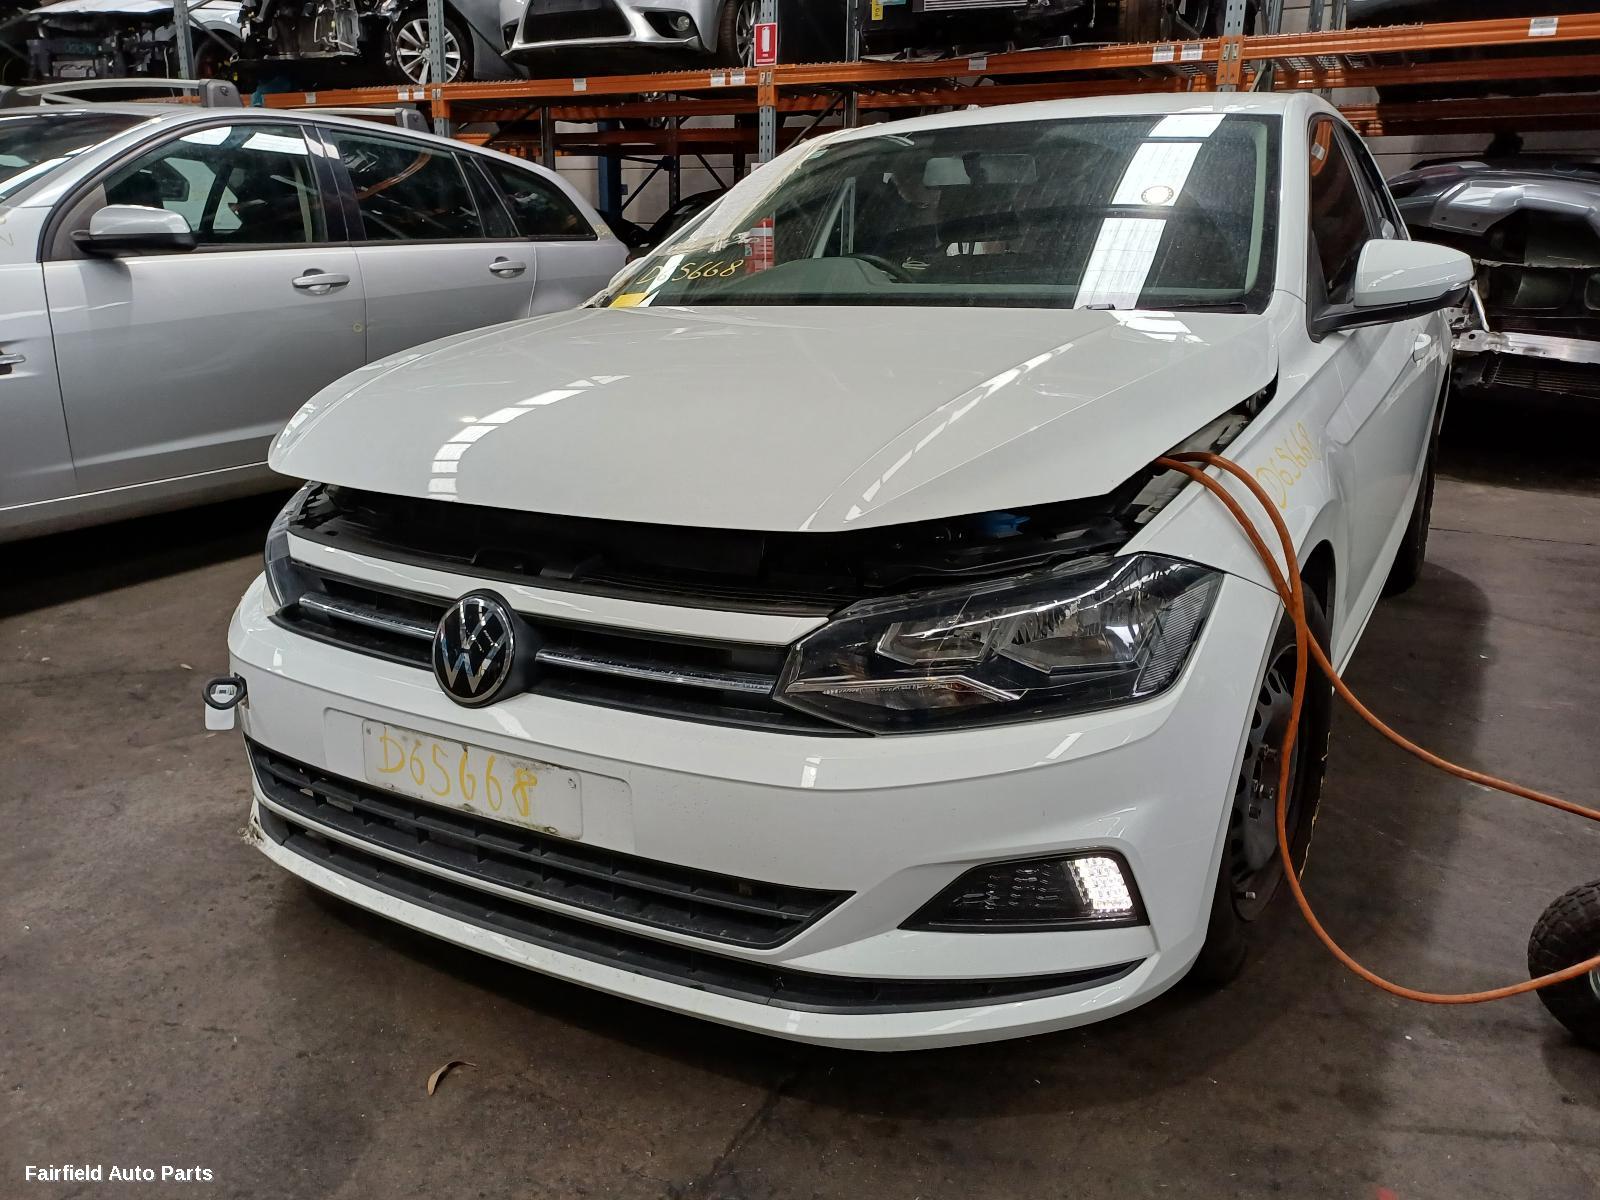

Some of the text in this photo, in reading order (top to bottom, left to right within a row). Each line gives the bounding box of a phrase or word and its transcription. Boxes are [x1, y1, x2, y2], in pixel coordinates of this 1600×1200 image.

[636, 259, 744, 285] D65668
[436, 594, 513, 700] VW
[376, 726, 538, 817] D65668
